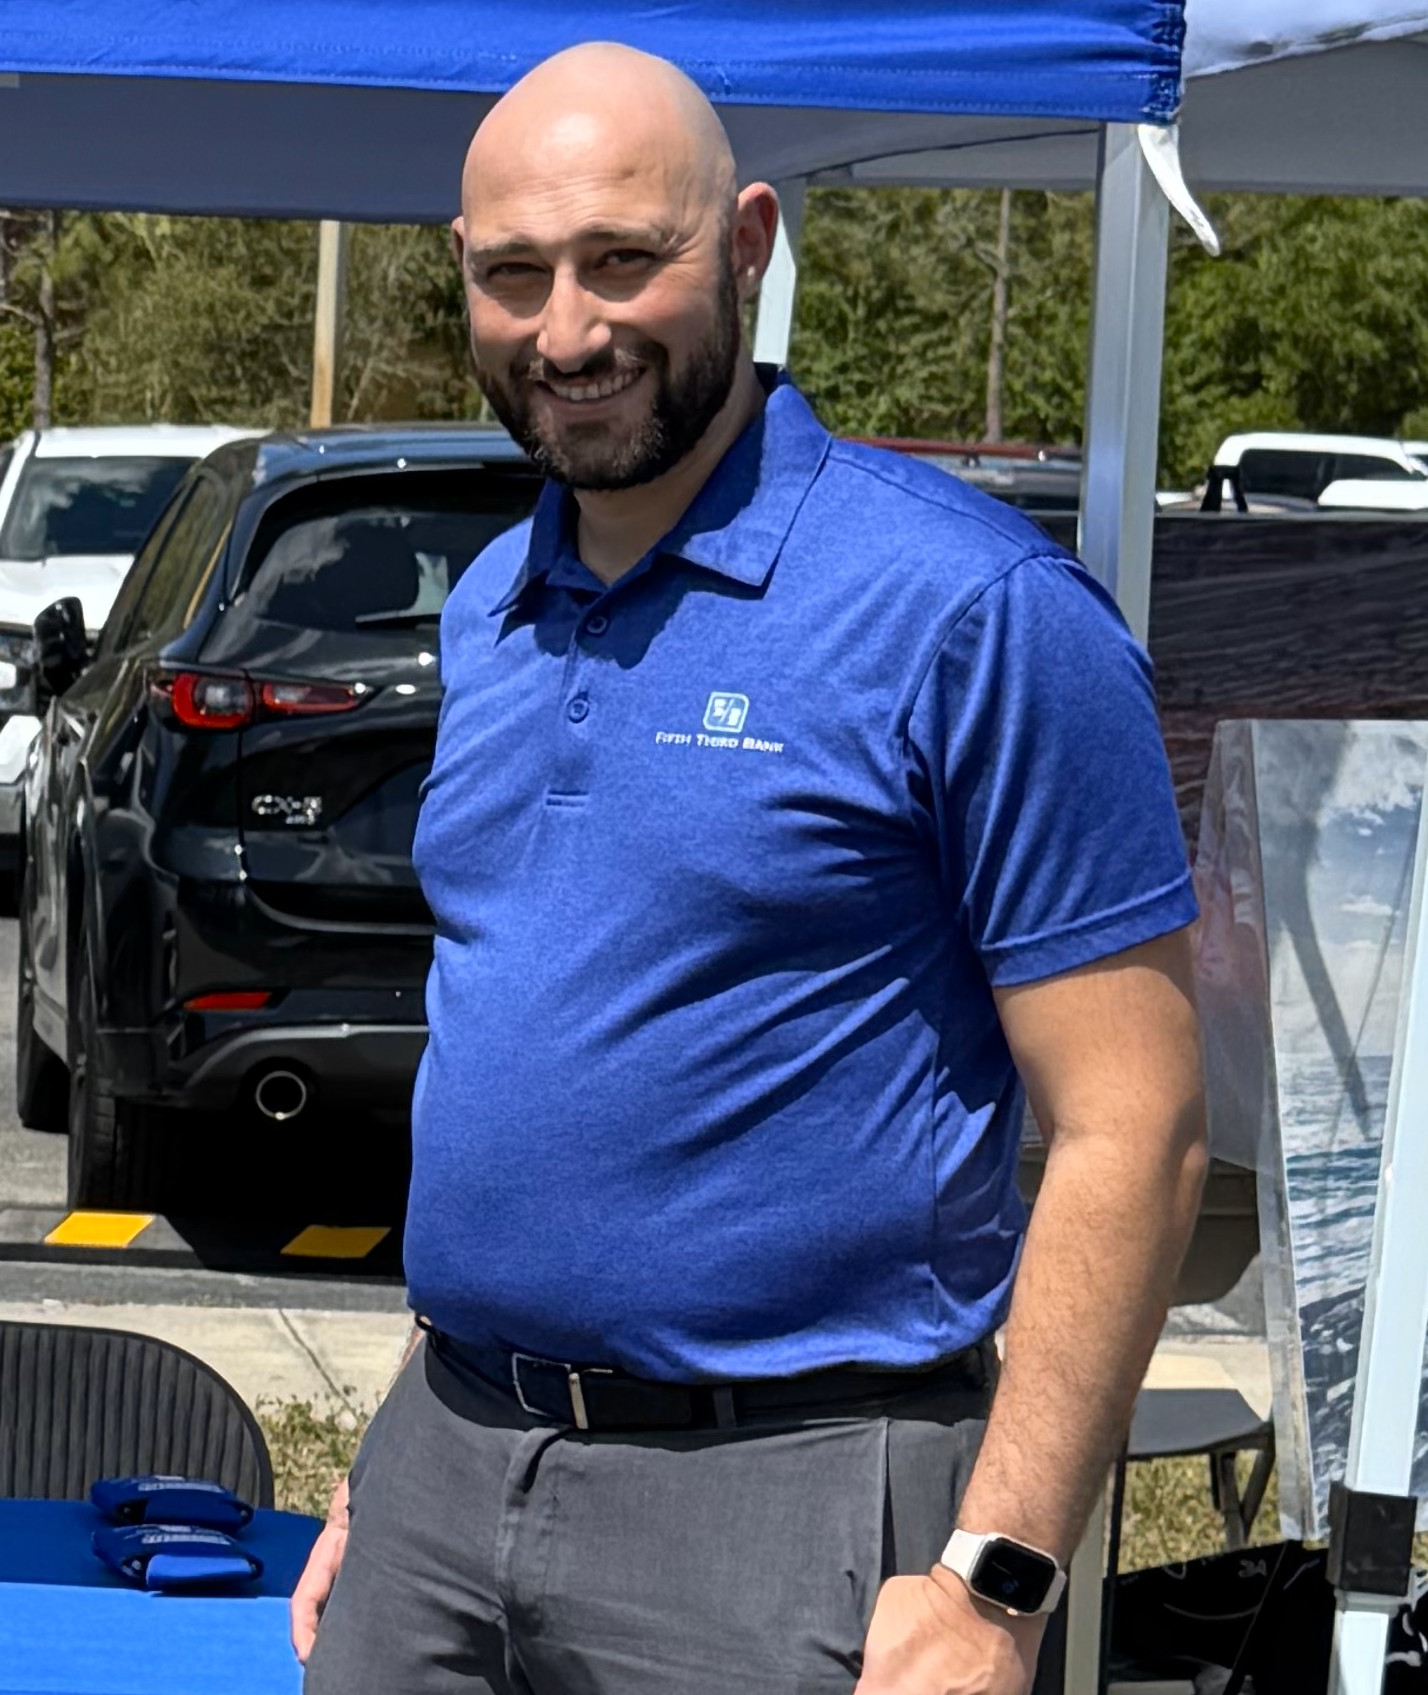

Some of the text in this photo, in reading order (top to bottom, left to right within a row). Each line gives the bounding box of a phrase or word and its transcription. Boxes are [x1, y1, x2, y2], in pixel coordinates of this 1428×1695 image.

[655, 731, 784, 753] FIFTH THIRD BANK
